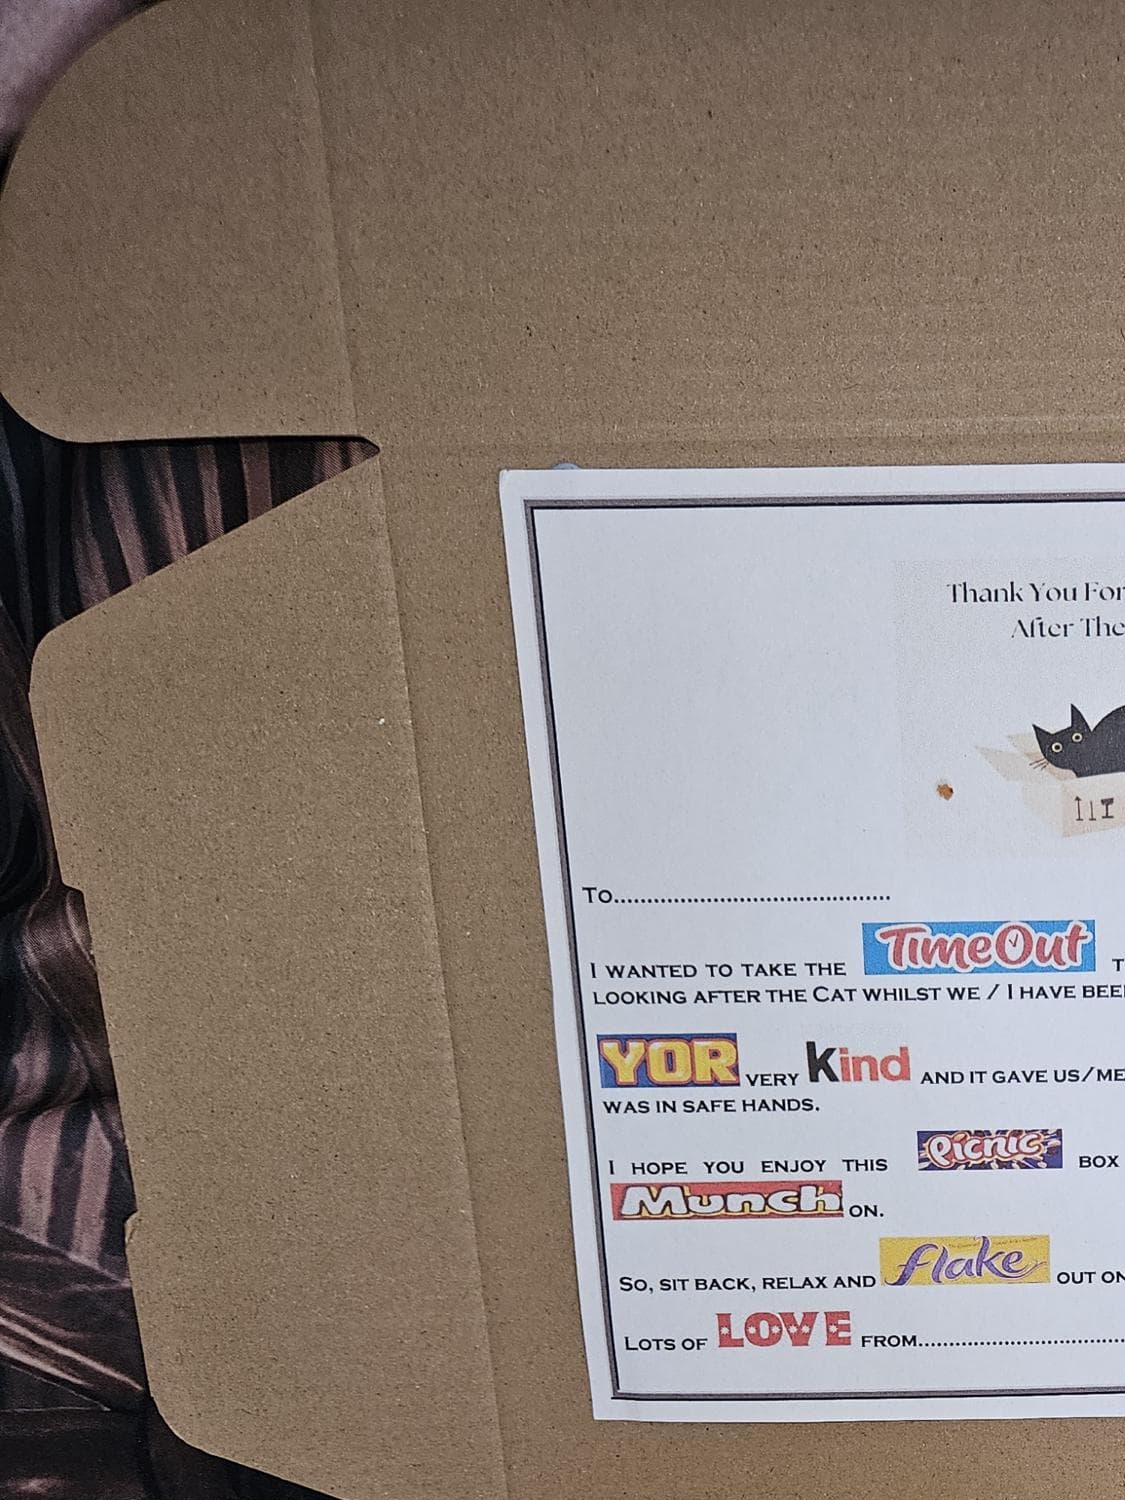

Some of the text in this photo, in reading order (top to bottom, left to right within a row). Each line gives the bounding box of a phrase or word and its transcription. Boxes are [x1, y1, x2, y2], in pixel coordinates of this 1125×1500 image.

[947, 581, 1023, 603] Thank
[1029, 583, 1077, 602] You
[1011, 617, 1074, 638] After
[1080, 616, 1125, 637] The
[590, 962, 597, 978] I
[605, 964, 697, 978] WANTED
[705, 964, 733, 977] TO
[741, 963, 797, 977] TAKE
[804, 962, 846, 976] THE
[878, 923, 1090, 971] TimeOut
[593, 991, 687, 1005] LOOKING
[693, 990, 761, 1004] AFTER
[765, 989, 807, 1003] THE
[862, 987, 941, 1001] WHILST
[946, 987, 980, 1000] WE
[1008, 984, 1012, 1000] I
[1020, 985, 1076, 999] HAVE
[600, 1038, 739, 1086] YOR
[745, 1073, 799, 1086] VERY
[806, 1041, 911, 1083] Kind
[920, 1071, 964, 1084] AND
[970, 1071, 987, 1084] IT
[992, 1070, 1048, 1083] GAVE
[603, 1098, 820, 1114] WAS IN SAFE HANDS.
[609, 1160, 614, 1175] I
[631, 1162, 688, 1175] HOPE
[703, 1161, 744, 1174] YOU
[761, 1160, 826, 1173] ENJOY
[842, 1159, 888, 1172] THIS
[927, 1131, 1044, 1167] Picnic
[1079, 1155, 1120, 1168] BOX
[620, 1183, 884, 1217] Munch ON.
[619, 1277, 653, 1294] SO,
[659, 1279, 689, 1291] SIT
[694, 1278, 756, 1293] BACK,
[762, 1276, 828, 1289] RELAX
[833, 1276, 876, 1288] AND
[883, 1236, 1048, 1286] flake
[1057, 1271, 1096, 1284] OUT
[624, 1336, 676, 1351] LOTS
[681, 1338, 708, 1350] OF
[716, 1310, 852, 1348] LOVE
